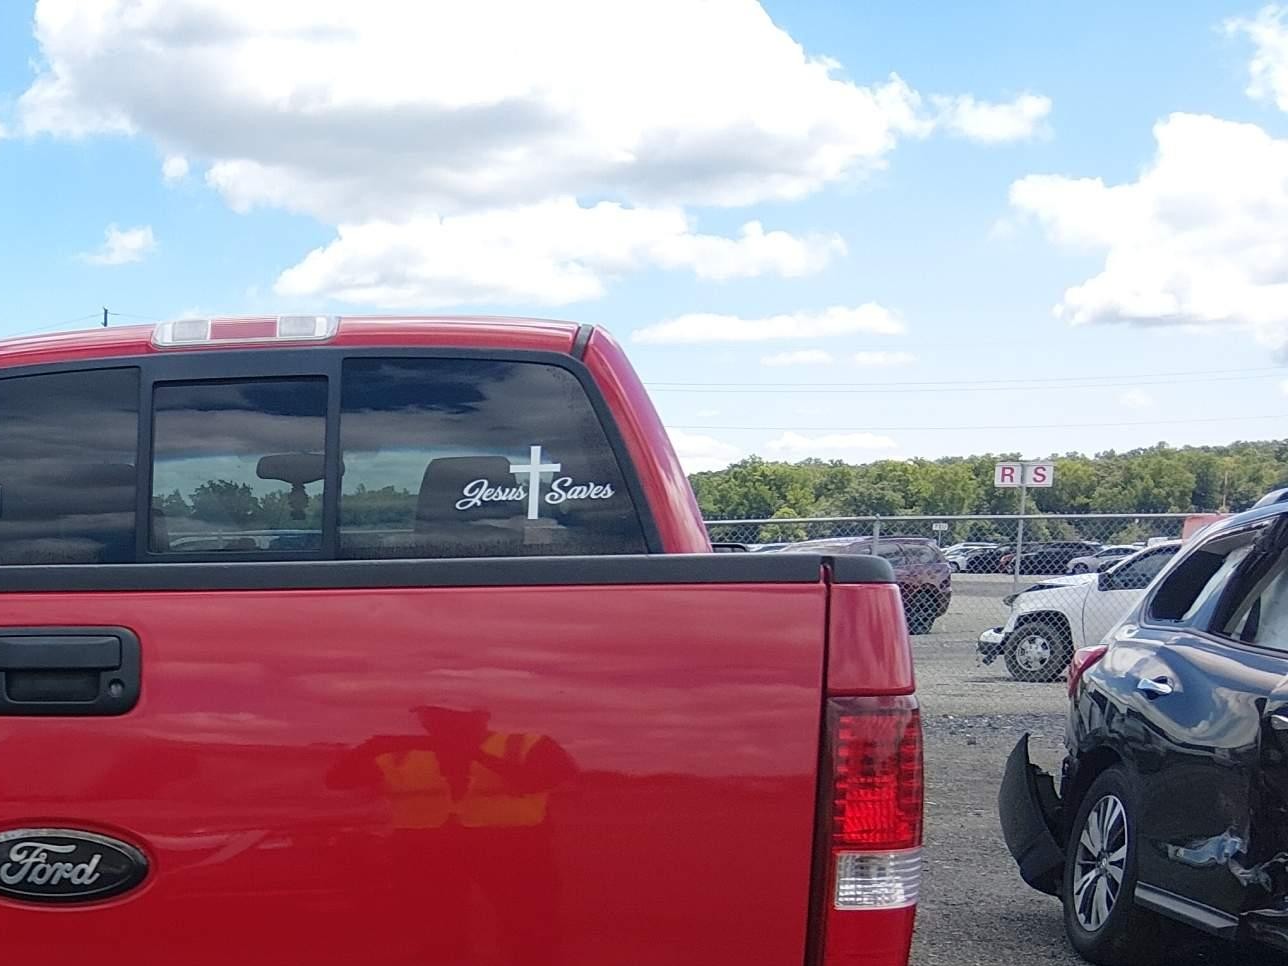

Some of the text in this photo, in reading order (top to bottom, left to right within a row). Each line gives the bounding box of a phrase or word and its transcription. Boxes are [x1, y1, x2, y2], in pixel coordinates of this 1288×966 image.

[1000, 466, 1015, 483] R
[1032, 466, 1047, 483] S
[455, 476, 615, 510] Jesus Saves
[0, 841, 103, 886] Ford
